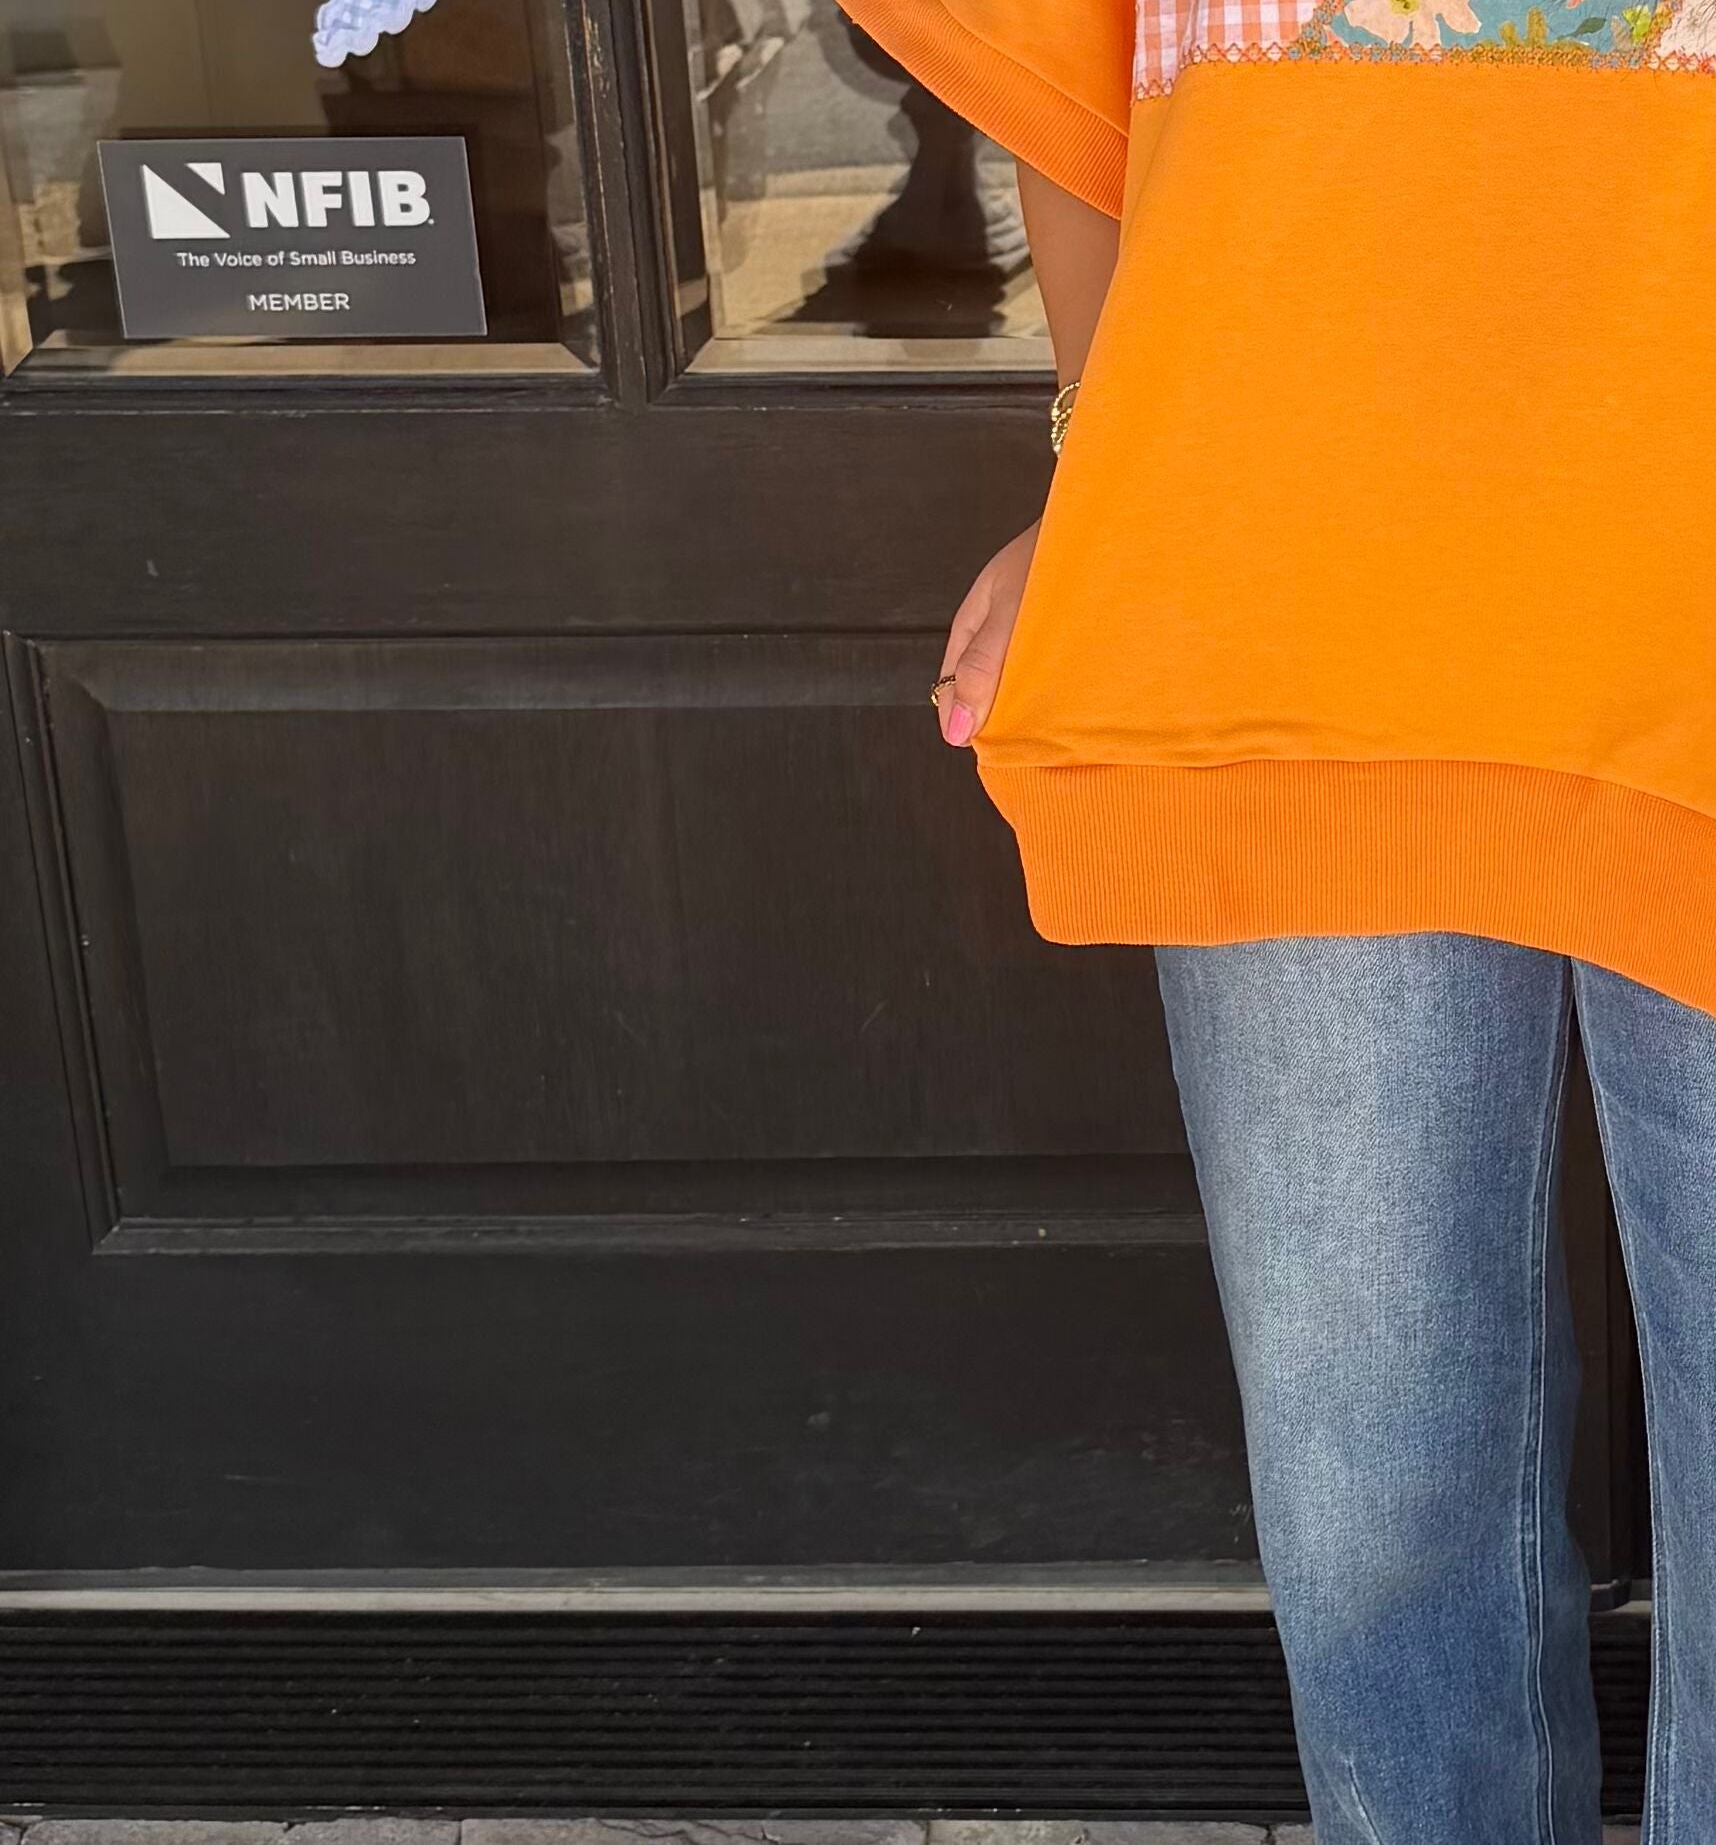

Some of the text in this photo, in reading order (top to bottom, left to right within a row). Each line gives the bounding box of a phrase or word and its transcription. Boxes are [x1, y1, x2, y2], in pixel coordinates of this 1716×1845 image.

[177, 250, 417, 268] The Voice of Small Business
[246, 293, 352, 312] MEMBER
